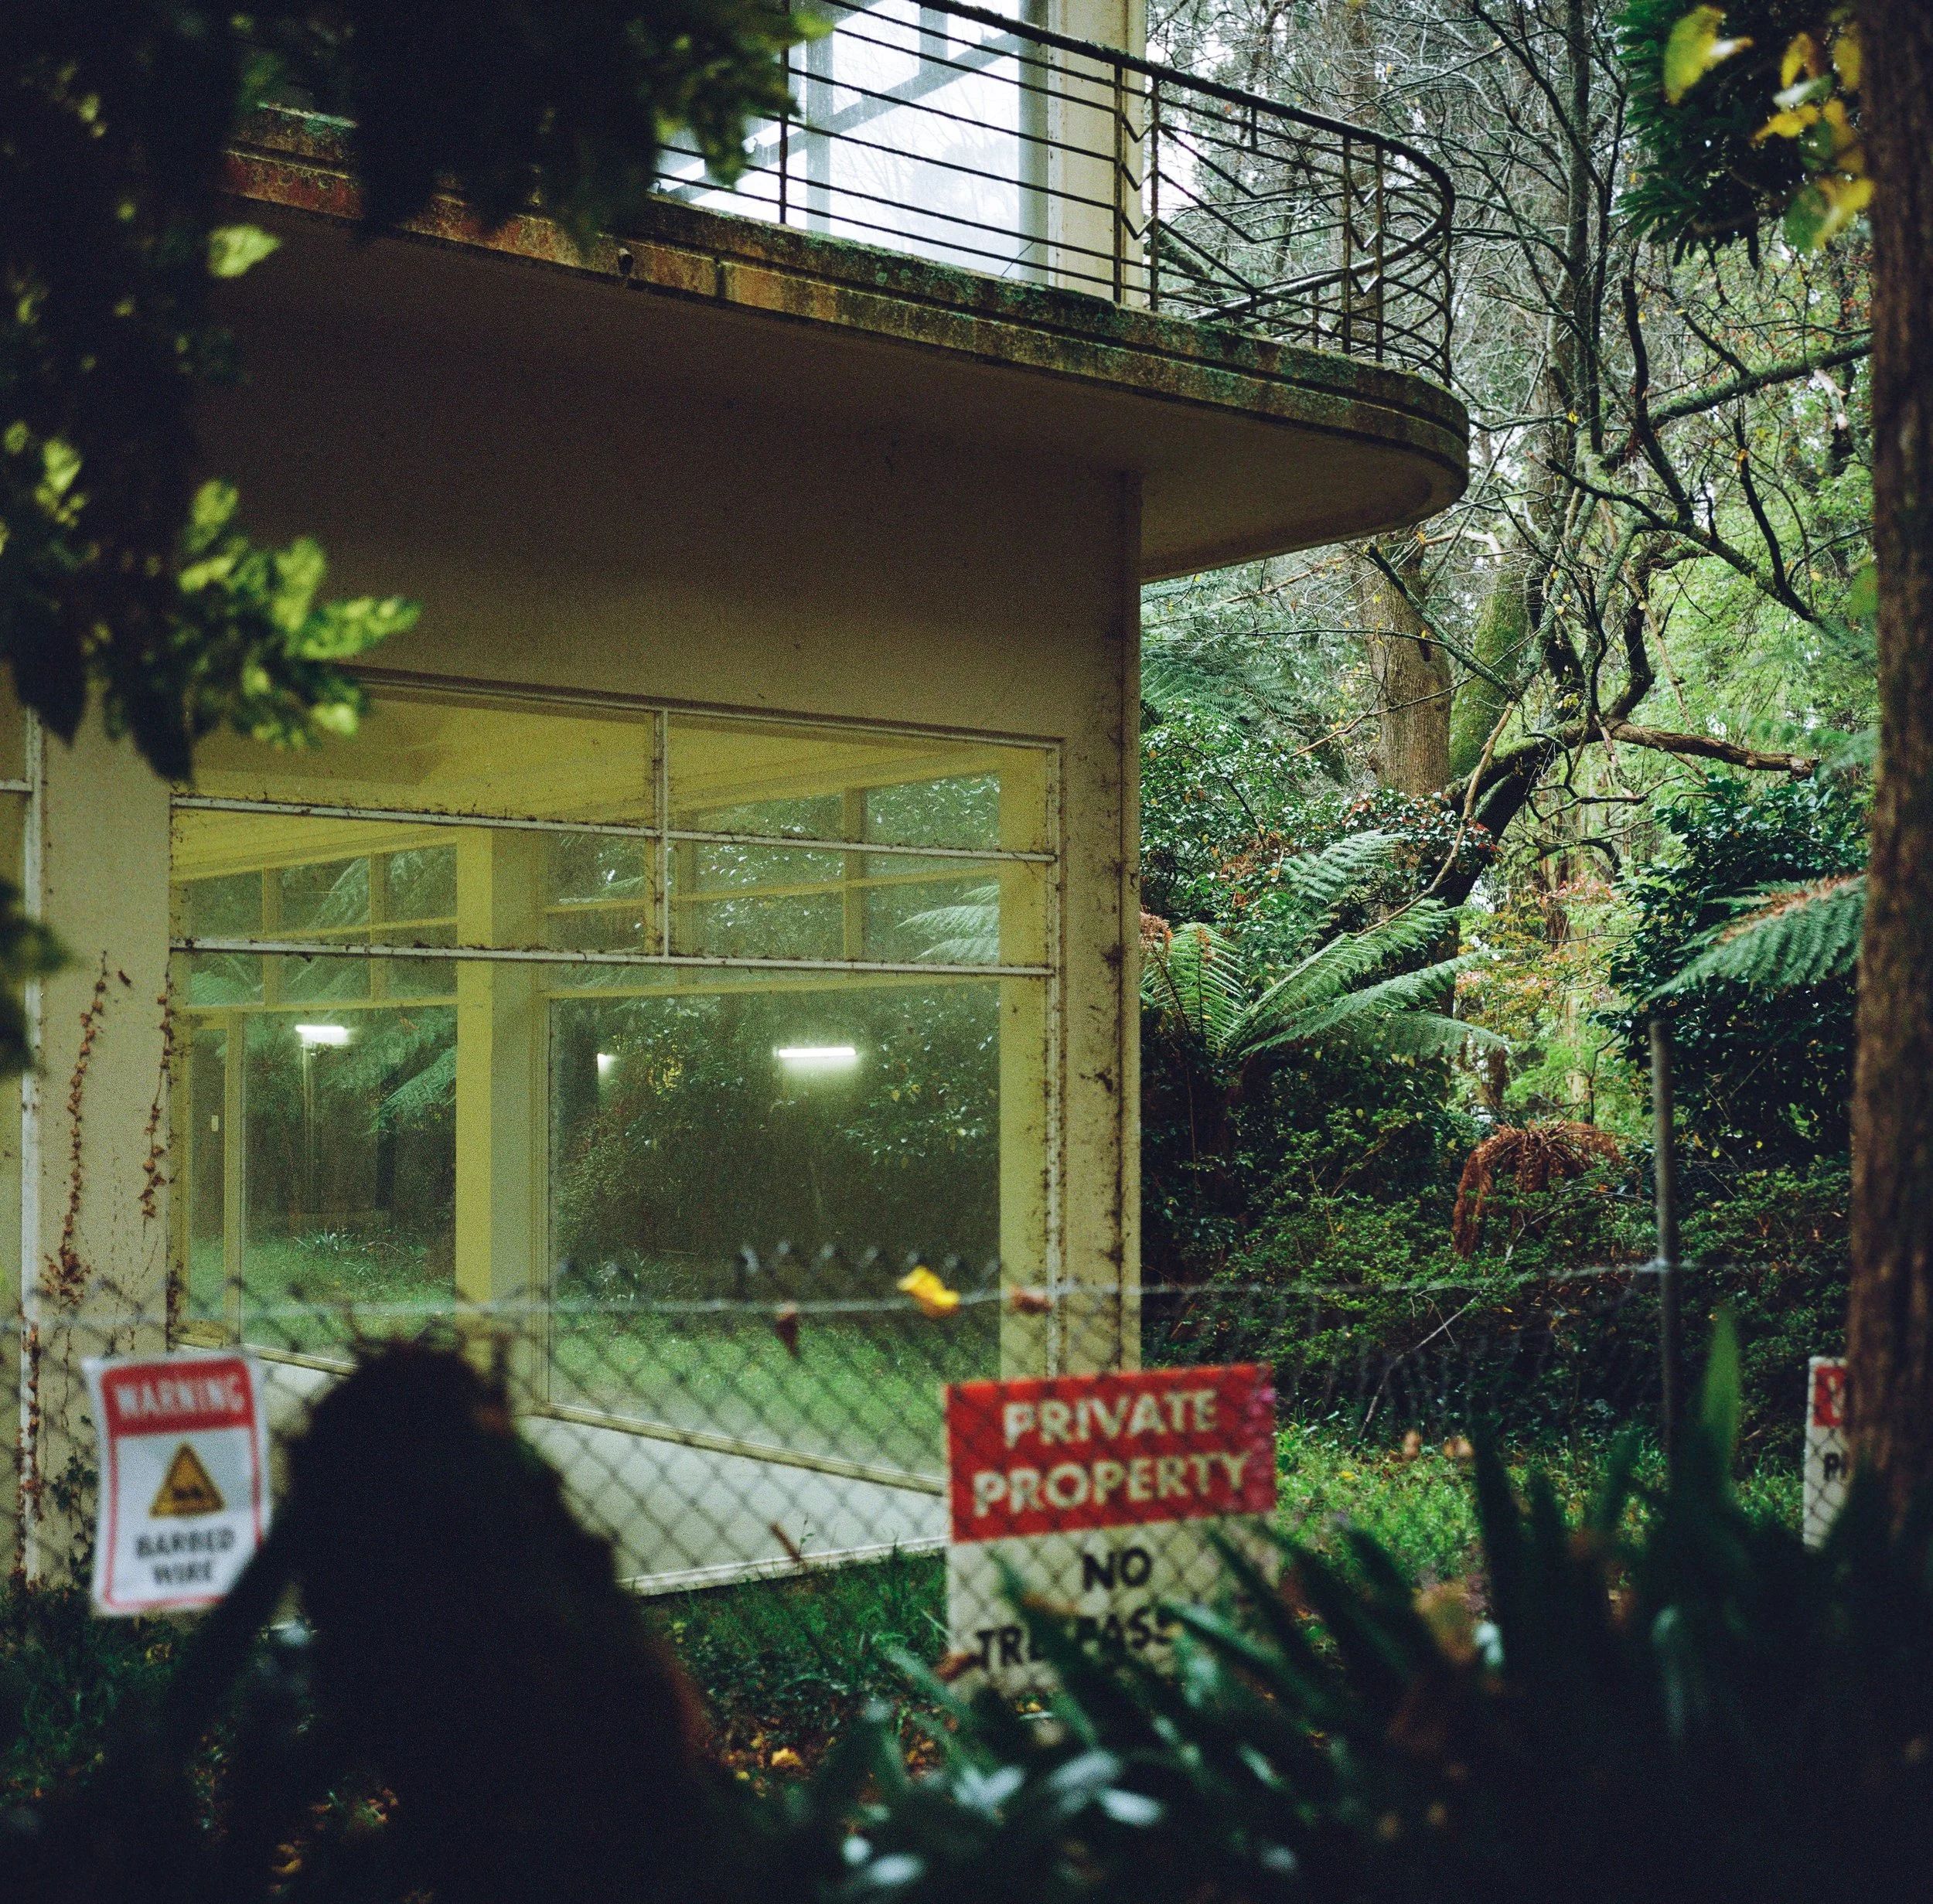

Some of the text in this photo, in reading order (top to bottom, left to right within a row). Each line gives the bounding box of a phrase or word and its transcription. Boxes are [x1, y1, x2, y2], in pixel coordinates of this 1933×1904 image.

[115, 1374, 246, 1417] WARNING
[1003, 1390, 1219, 1449] PRIVATE
[972, 1452, 1251, 1517] PROPERTY
[135, 1528, 234, 1558] BARBED
[152, 1561, 212, 1583] WIRE
[1082, 1547, 1152, 1591] NO
